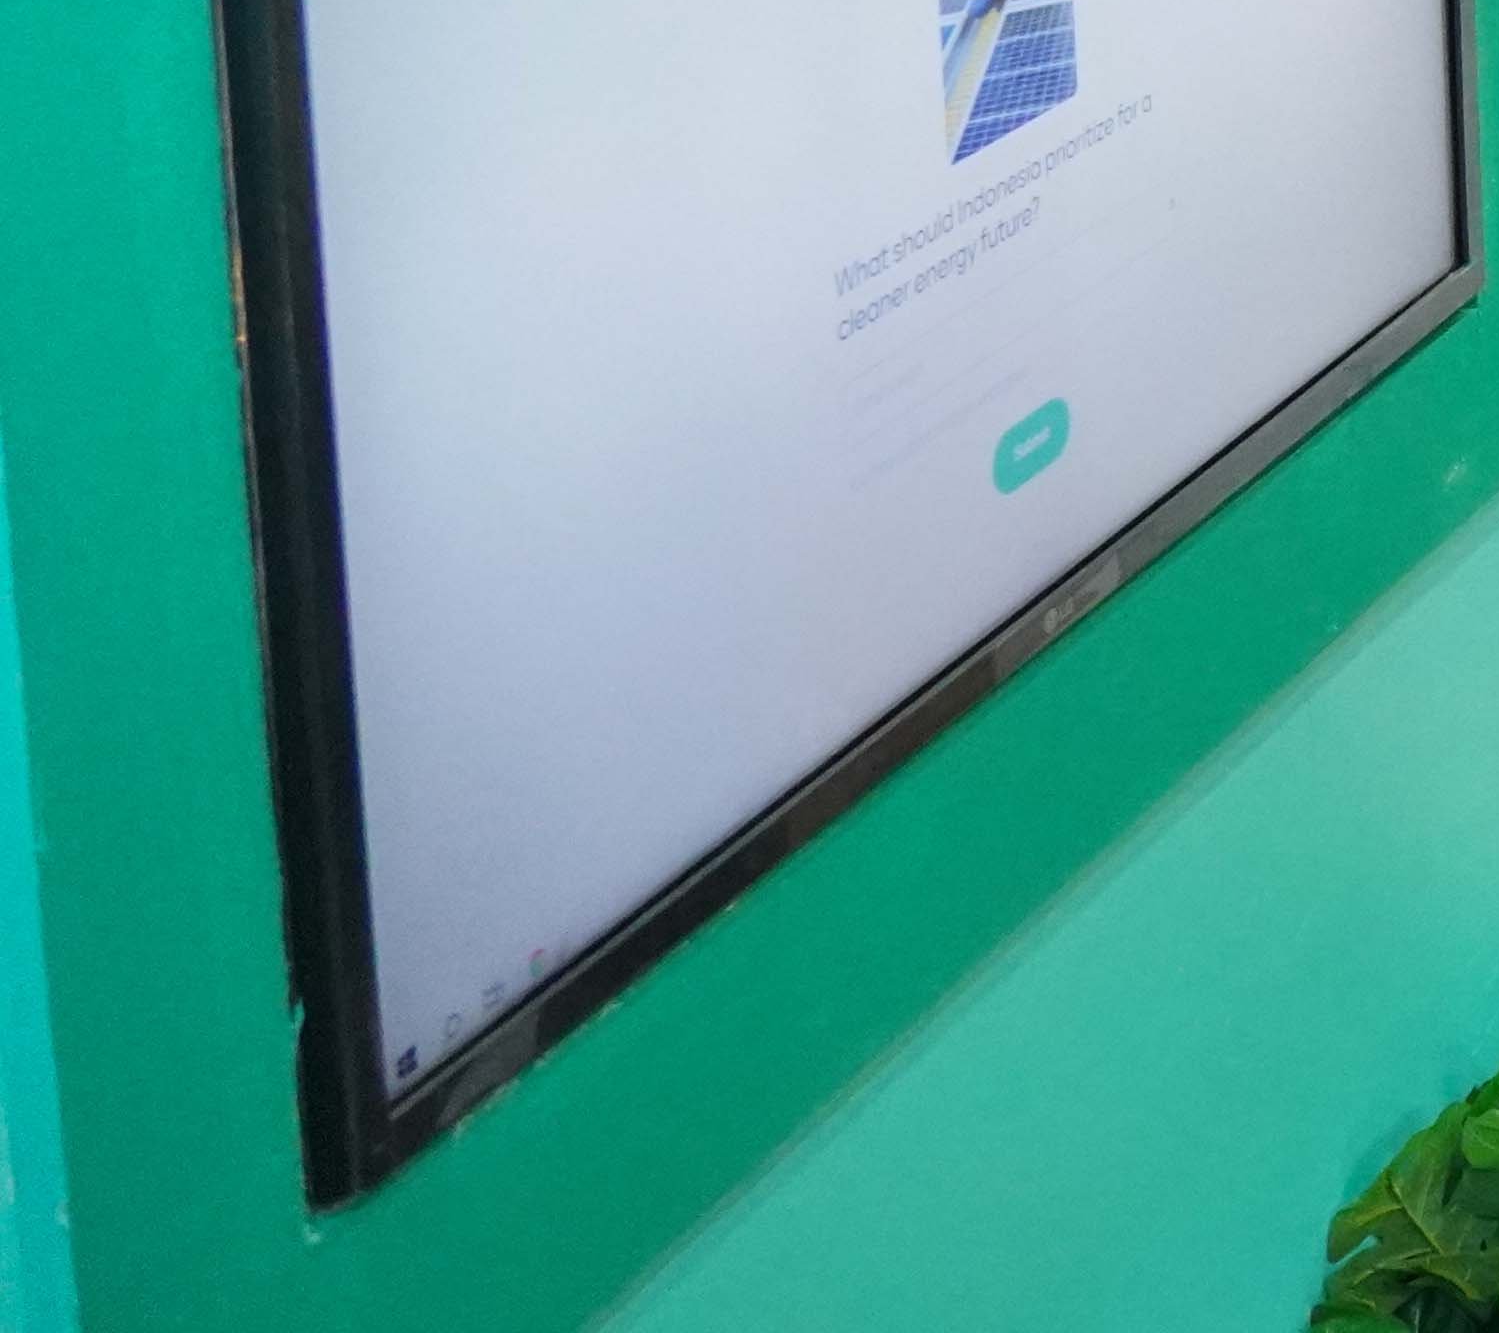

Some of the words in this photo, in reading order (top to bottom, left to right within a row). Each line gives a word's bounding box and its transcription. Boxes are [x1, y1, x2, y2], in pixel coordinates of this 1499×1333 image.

[833, 247, 889, 298] What
[892, 209, 954, 264] should
[957, 161, 1042, 225] Indonesia
[1045, 118, 1115, 175] prioritize
[1117, 100, 1141, 129] for
[1141, 93, 1153, 113] a
[836, 280, 913, 342] cleaner
[914, 242, 978, 295] energy
[978, 196, 1041, 254] future?
